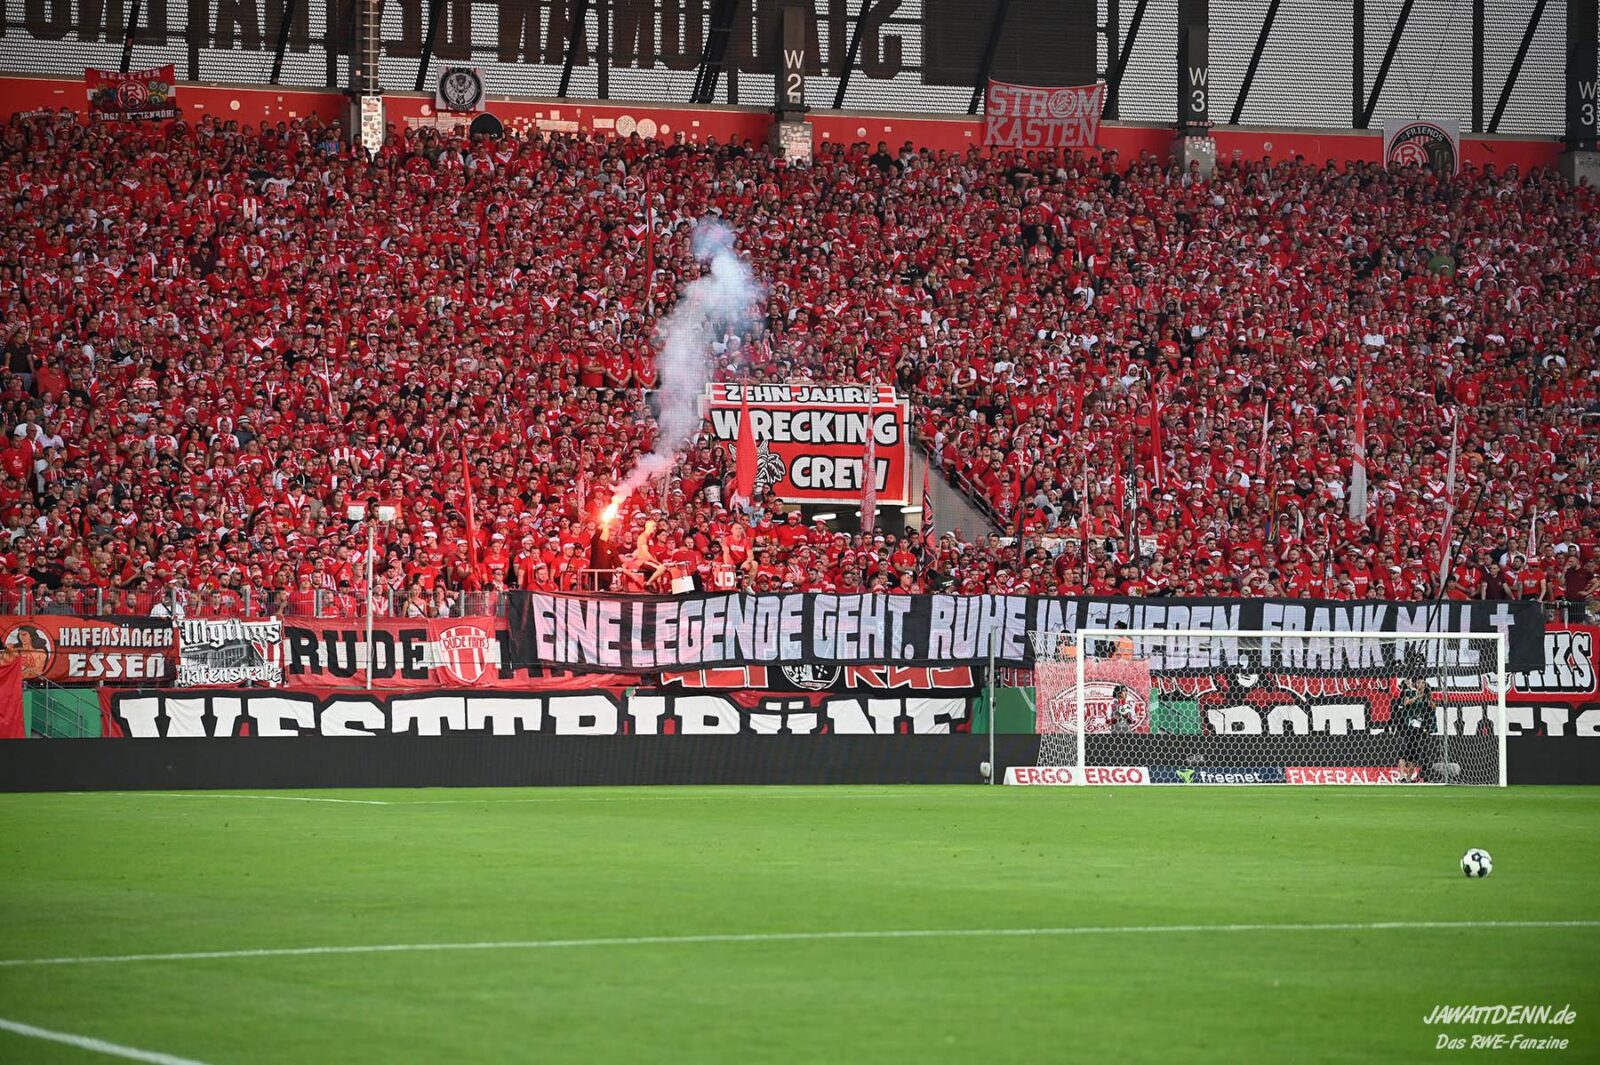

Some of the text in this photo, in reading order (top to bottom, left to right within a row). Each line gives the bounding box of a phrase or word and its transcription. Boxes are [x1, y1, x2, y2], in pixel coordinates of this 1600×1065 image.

[784, 50, 804, 69] W
[100, 69, 161, 80] SEKTION
[1189, 67, 1207, 86] W
[787, 74, 802, 96] 2
[1578, 81, 1597, 99] W
[1191, 90, 1205, 112] 3
[1581, 104, 1595, 126] 3
[983, 116, 1098, 148] KASTEN
[1405, 125, 1444, 142] FRIENDS
[725, 384, 879, 403] ZEHN JAHRE
[711, 408, 898, 445] WRECKING
[791, 456, 888, 490] CREW
[59, 624, 174, 648] HAFENSÄNGER
[532, 593, 622, 667] EINE
[631, 592, 803, 668] LEGENDE
[813, 592, 915, 660] GEHT.
[928, 594, 1026, 661] RUHE
[1036, 599, 1078, 660] IN
[1084, 601, 1249, 671] FRIEDEN,
[1261, 602, 1389, 670] FRANK
[1395, 603, 1480, 668] MILL
[284, 626, 429, 679] RUDE
[443, 637, 466, 649] RUDE
[68, 653, 165, 678] ESSEN
[1014, 767, 1073, 784] ERGO
[1085, 767, 1143, 784] ERGO
[1200, 770, 1261, 784] freenet
[1288, 769, 1403, 785] FLYERALAR
